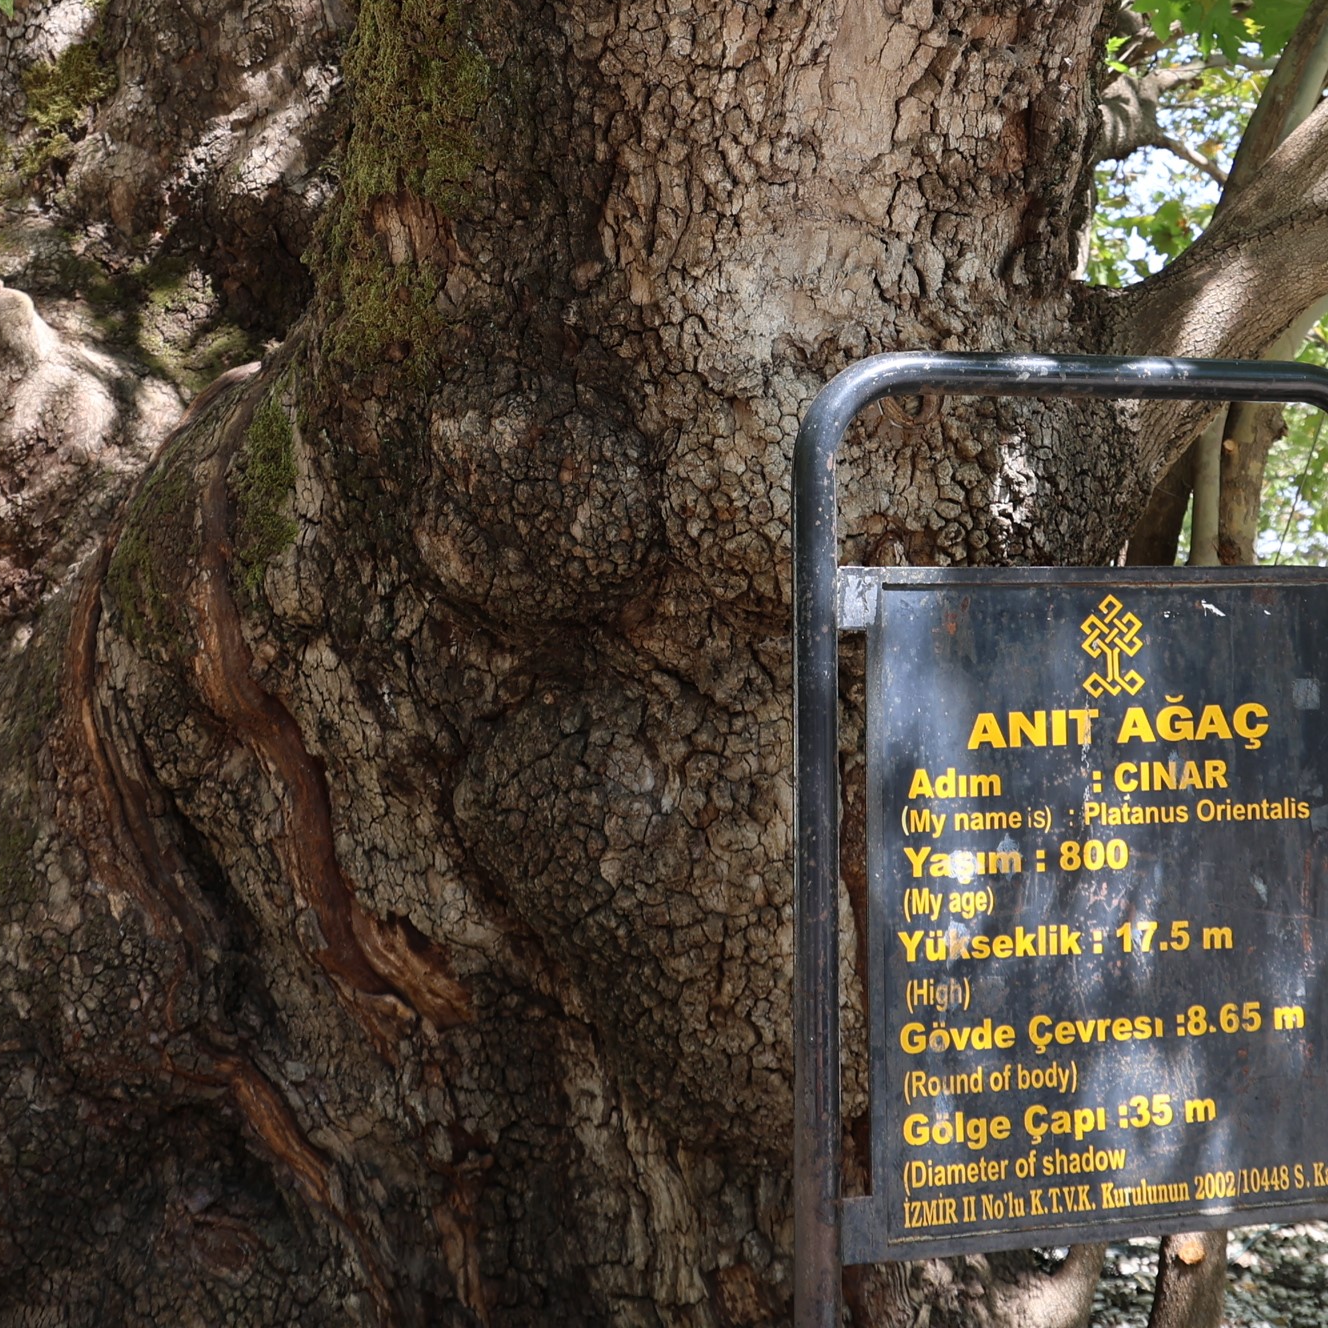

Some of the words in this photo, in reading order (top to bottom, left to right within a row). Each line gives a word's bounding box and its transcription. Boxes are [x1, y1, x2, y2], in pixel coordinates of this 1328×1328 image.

[967, 708, 1099, 750] ANIT
[1117, 694, 1270, 750] AĞAÇ
[908, 768, 1001, 799] Adım
[901, 805, 946, 838] (My
[954, 811, 1022, 830] name
[1028, 808, 1052, 831] is)
[1084, 802, 1189, 826] Platanus
[1197, 798, 1310, 822] Orientalis
[1060, 839, 1130, 871] 800
[903, 888, 942, 923] (My
[949, 889, 994, 919] age)
[898, 924, 1082, 962] Yükseklik
[1115, 920, 1190, 952] 17.5
[1202, 927, 1233, 949] m
[906, 979, 970, 1012] (High)
[900, 1018, 1015, 1054] Gövde
[1272, 1007, 1304, 1031] m
[903, 1070, 984, 1104] (Round
[989, 1066, 1011, 1092] of
[1017, 1061, 1077, 1093] body)
[903, 1111, 1011, 1150] Gölge
[1184, 1098, 1216, 1123] m
[903, 1159, 1008, 1197] (Diameter
[1015, 1150, 1036, 1178] of
[1043, 1146, 1126, 1175] shadow
[903, 1193, 959, 1228] İZMİR
[962, 1196, 976, 1221] II
[1030, 1185, 1096, 1215] K.T.V.K.
[1101, 1180, 1190, 1209] Kurulunun
[1194, 1165, 1289, 1200] 2002/10448
[1294, 1164, 1310, 1189] S.
